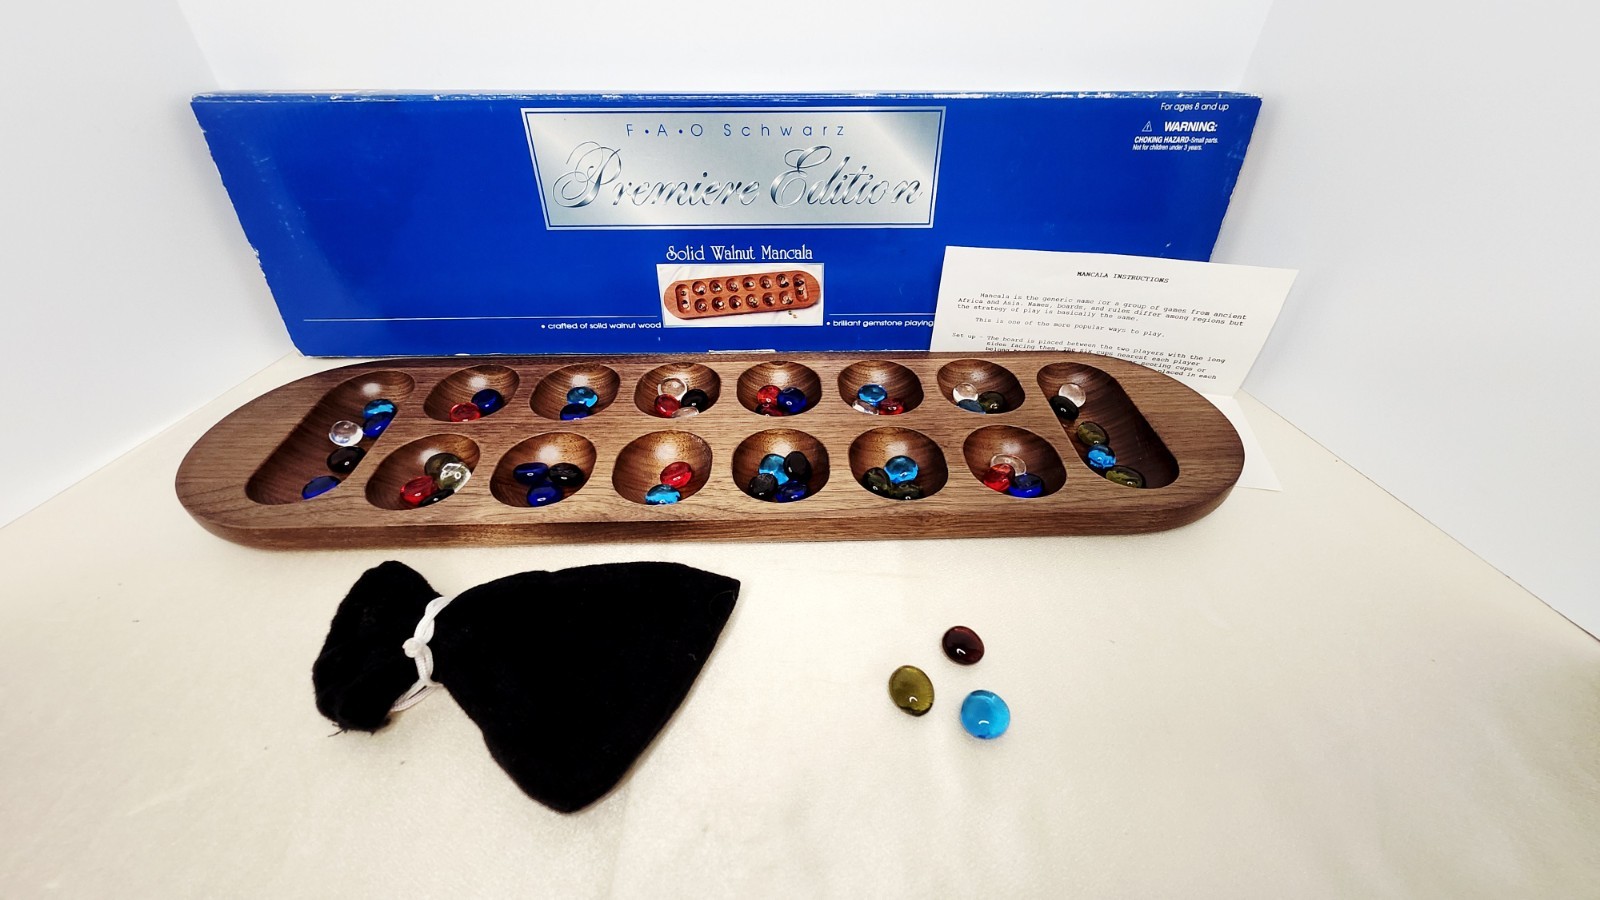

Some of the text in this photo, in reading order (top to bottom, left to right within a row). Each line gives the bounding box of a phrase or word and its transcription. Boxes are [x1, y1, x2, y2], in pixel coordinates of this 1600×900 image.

[1160, 102, 1229, 112] For ages 8 and up
[723, 123, 845, 137] Schwarz
[1164, 121, 1218, 132] WARNING:
[1134, 136, 1163, 144] CHOKING
[552, 141, 924, 209] Premiere Edition
[666, 243, 813, 261] Solid Walnut Mancala
[1113, 273, 1170, 284] INSTRUCTIONS
[973, 304, 1007, 313] strategy
[1023, 307, 1041, 315] play
[1057, 309, 1095, 318] basically
[1042, 295, 1073, 304] generic
[1123, 302, 1147, 310] group
[1163, 306, 1187, 314] games
[1191, 308, 1210, 316] from
[1213, 311, 1247, 320] ancient
[833, 319, 935, 328] brilliant gemstone playing
[1134, 308, 1162, 317] differ
[1165, 313, 1189, 321] among
[1193, 316, 1225, 325] regions
[1229, 319, 1244, 327] but
[547, 322, 578, 330] crafted
[637, 321, 661, 329] wood
[1074, 323, 1105, 332] popular
[1067, 341, 1096, 349] between
[1133, 348, 1164, 357] players
[1207, 356, 1226, 364] long
[1117, 352, 1148, 360] nearest
[1173, 358, 1201, 366] player
